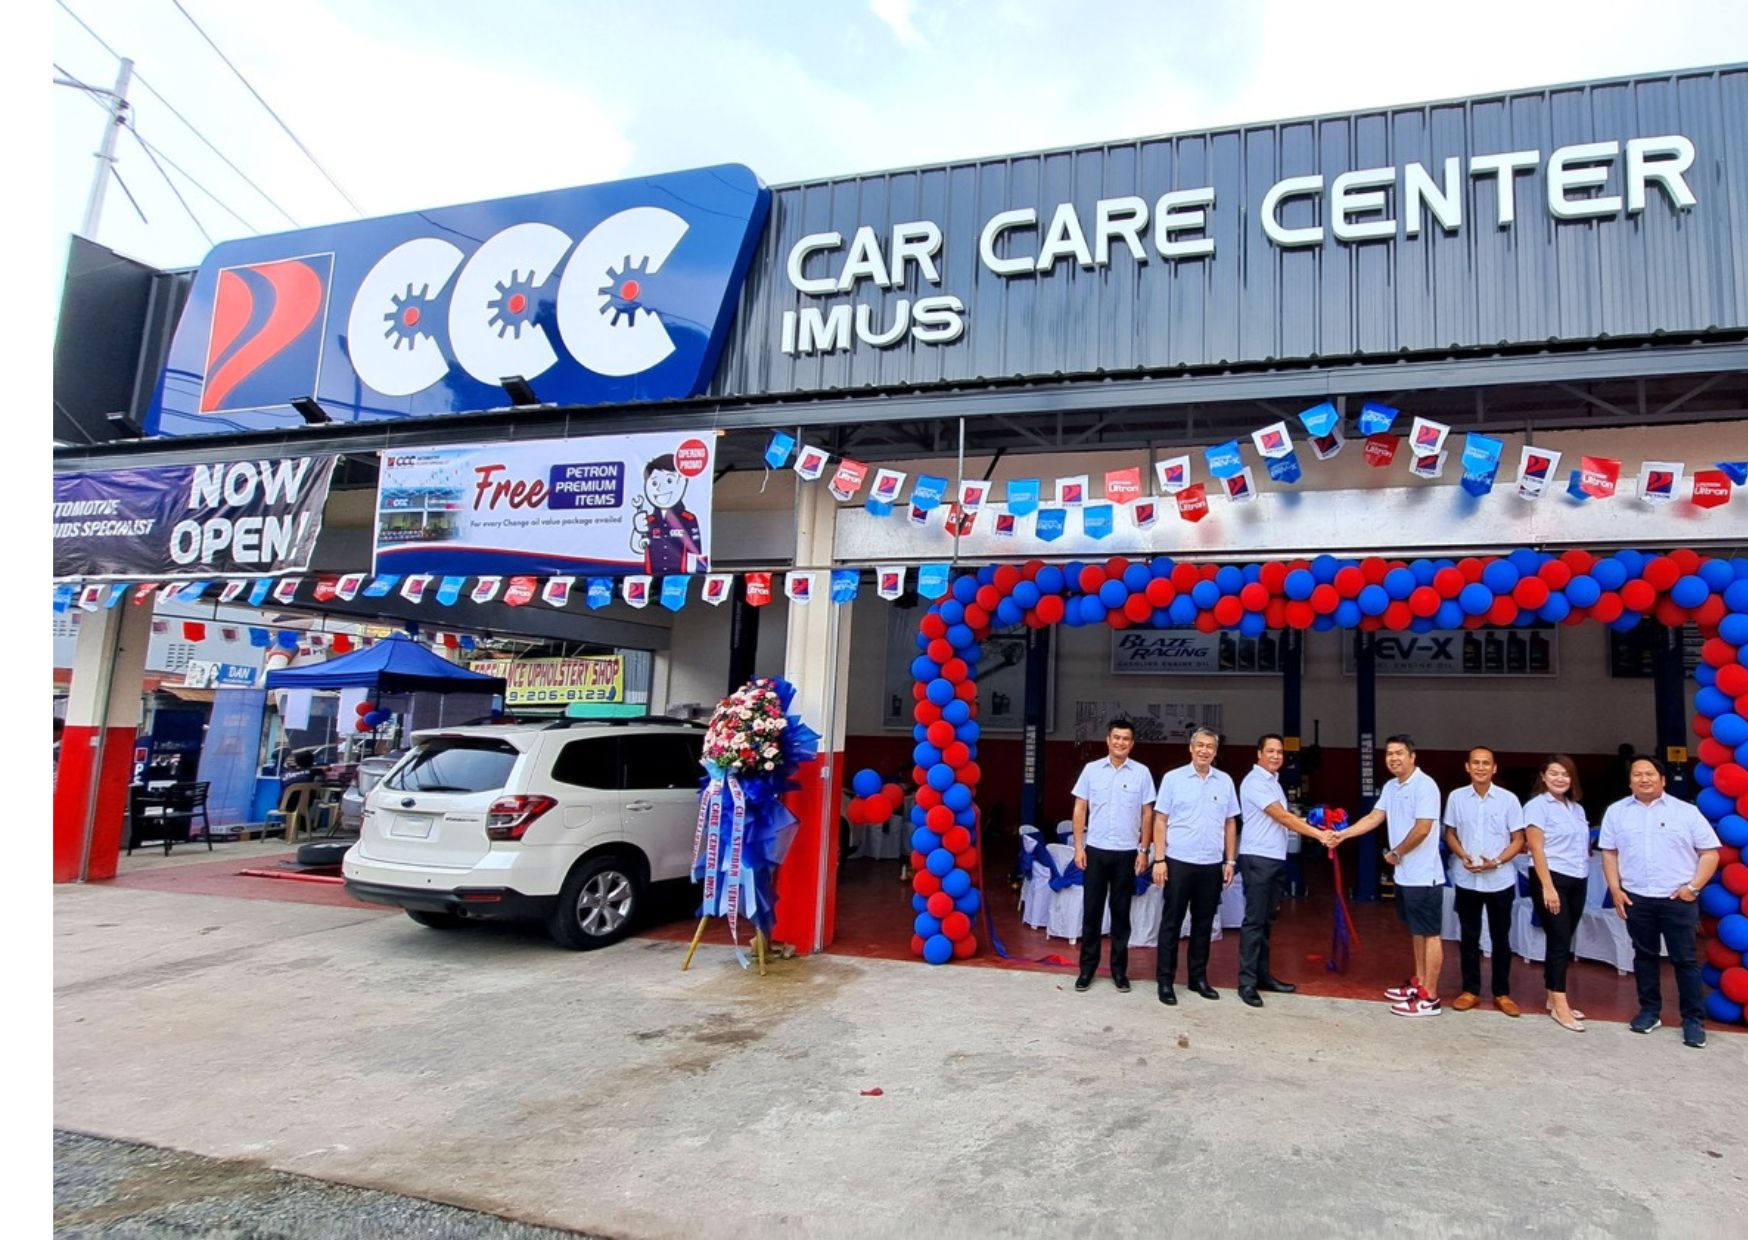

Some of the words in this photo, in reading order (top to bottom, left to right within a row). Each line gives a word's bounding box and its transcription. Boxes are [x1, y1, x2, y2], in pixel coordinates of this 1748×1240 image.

[786, 219, 943, 294] CAR
[978, 186, 1216, 275] CARE
[1259, 133, 1697, 248] CENTER
[347, 206, 690, 397] CCC
[780, 294, 966, 356] IMUS
[188, 457, 312, 510] NOW
[566, 466, 617, 478] PETRON
[474, 464, 551, 511] Free
[555, 480, 616, 493] PREMIUM
[1694, 487, 1728, 496] Ultron
[575, 494, 615, 506] ITEMS
[80, 519, 156, 538] SPECIALIST
[482, 520, 502, 528] every
[503, 518, 530, 527] Change
[531, 517, 540, 526] oil
[541, 516, 560, 525] value
[562, 515, 593, 526] package
[594, 515, 623, 524] availed
[169, 511, 310, 565] OPEN!
[1119, 633, 1195, 650] BLAZE
[1129, 647, 1210, 660] RACING
[592, 658, 619, 686] SHOP
[710, 802, 721, 827] CARE
[706, 833, 719, 870] CENTER
